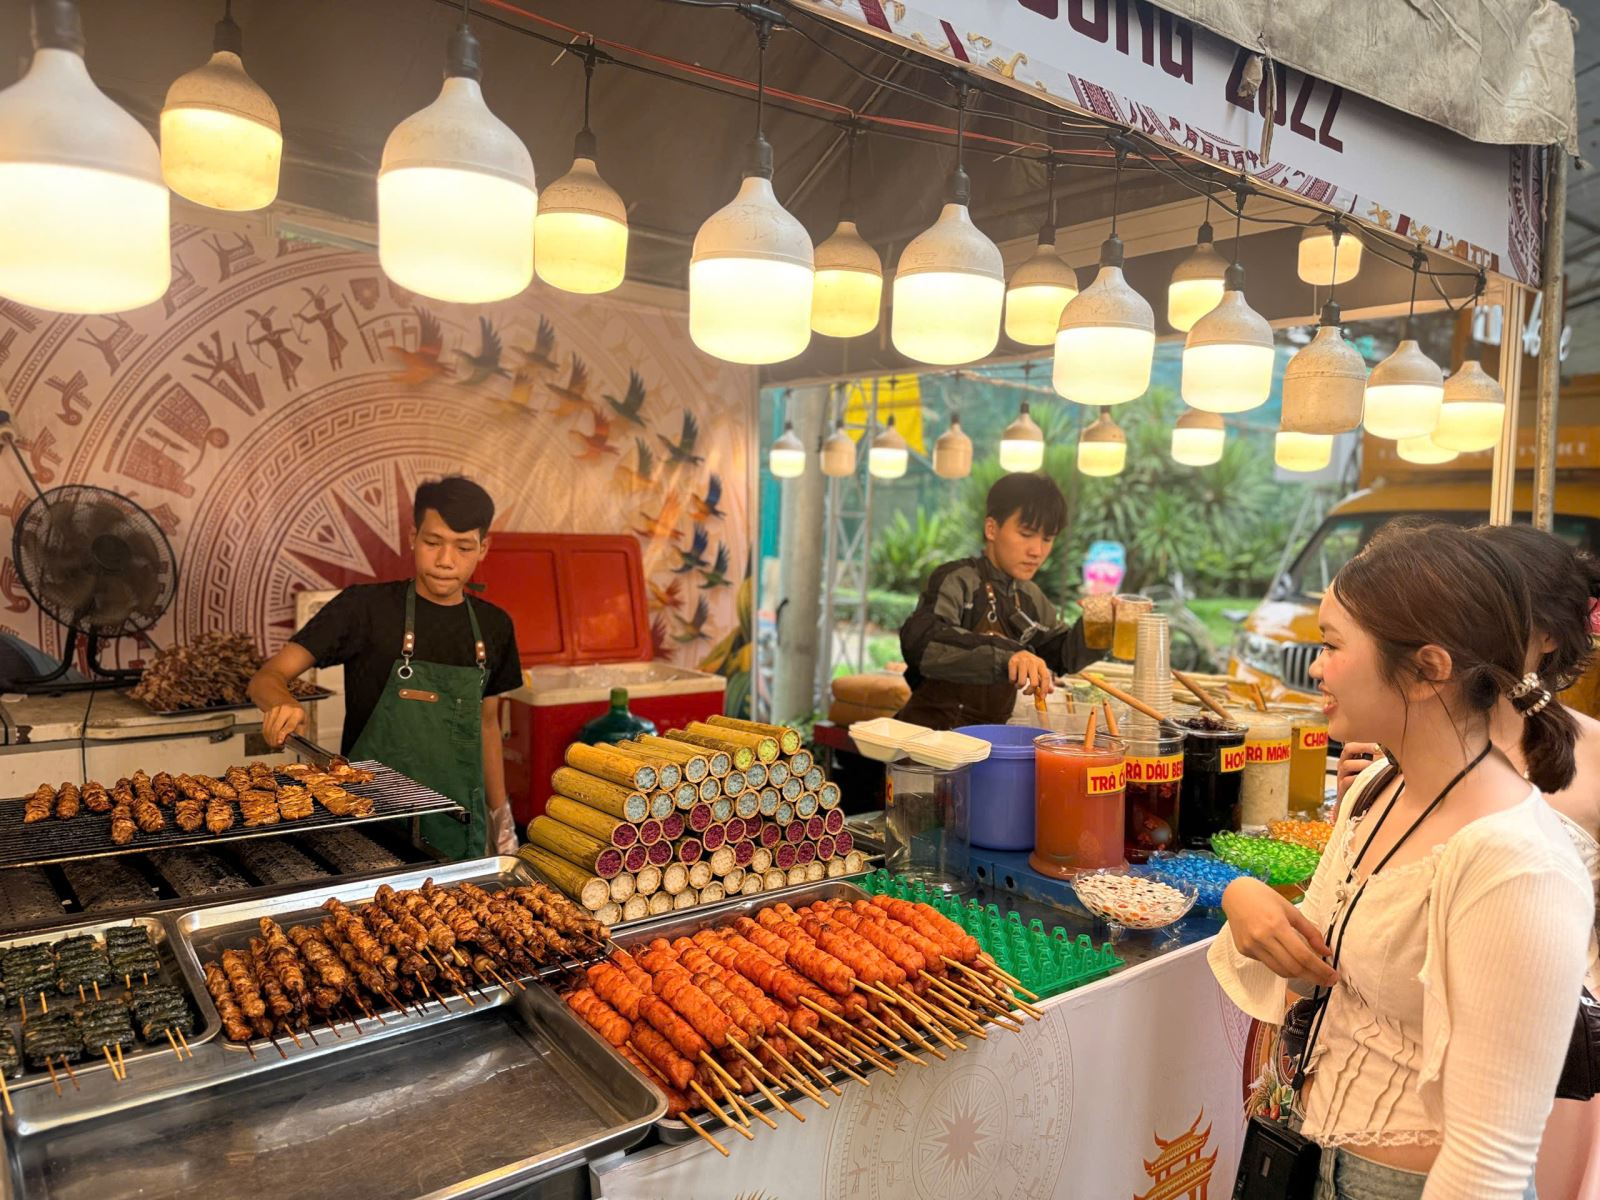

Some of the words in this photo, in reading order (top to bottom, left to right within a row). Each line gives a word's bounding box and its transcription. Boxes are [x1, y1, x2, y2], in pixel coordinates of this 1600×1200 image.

[1246, 743, 1262, 761] RÀ
[1126, 760, 1142, 780] RÀ
[1146, 760, 1169, 780] DÂU
[1091, 771, 1116, 791] TRÀ
